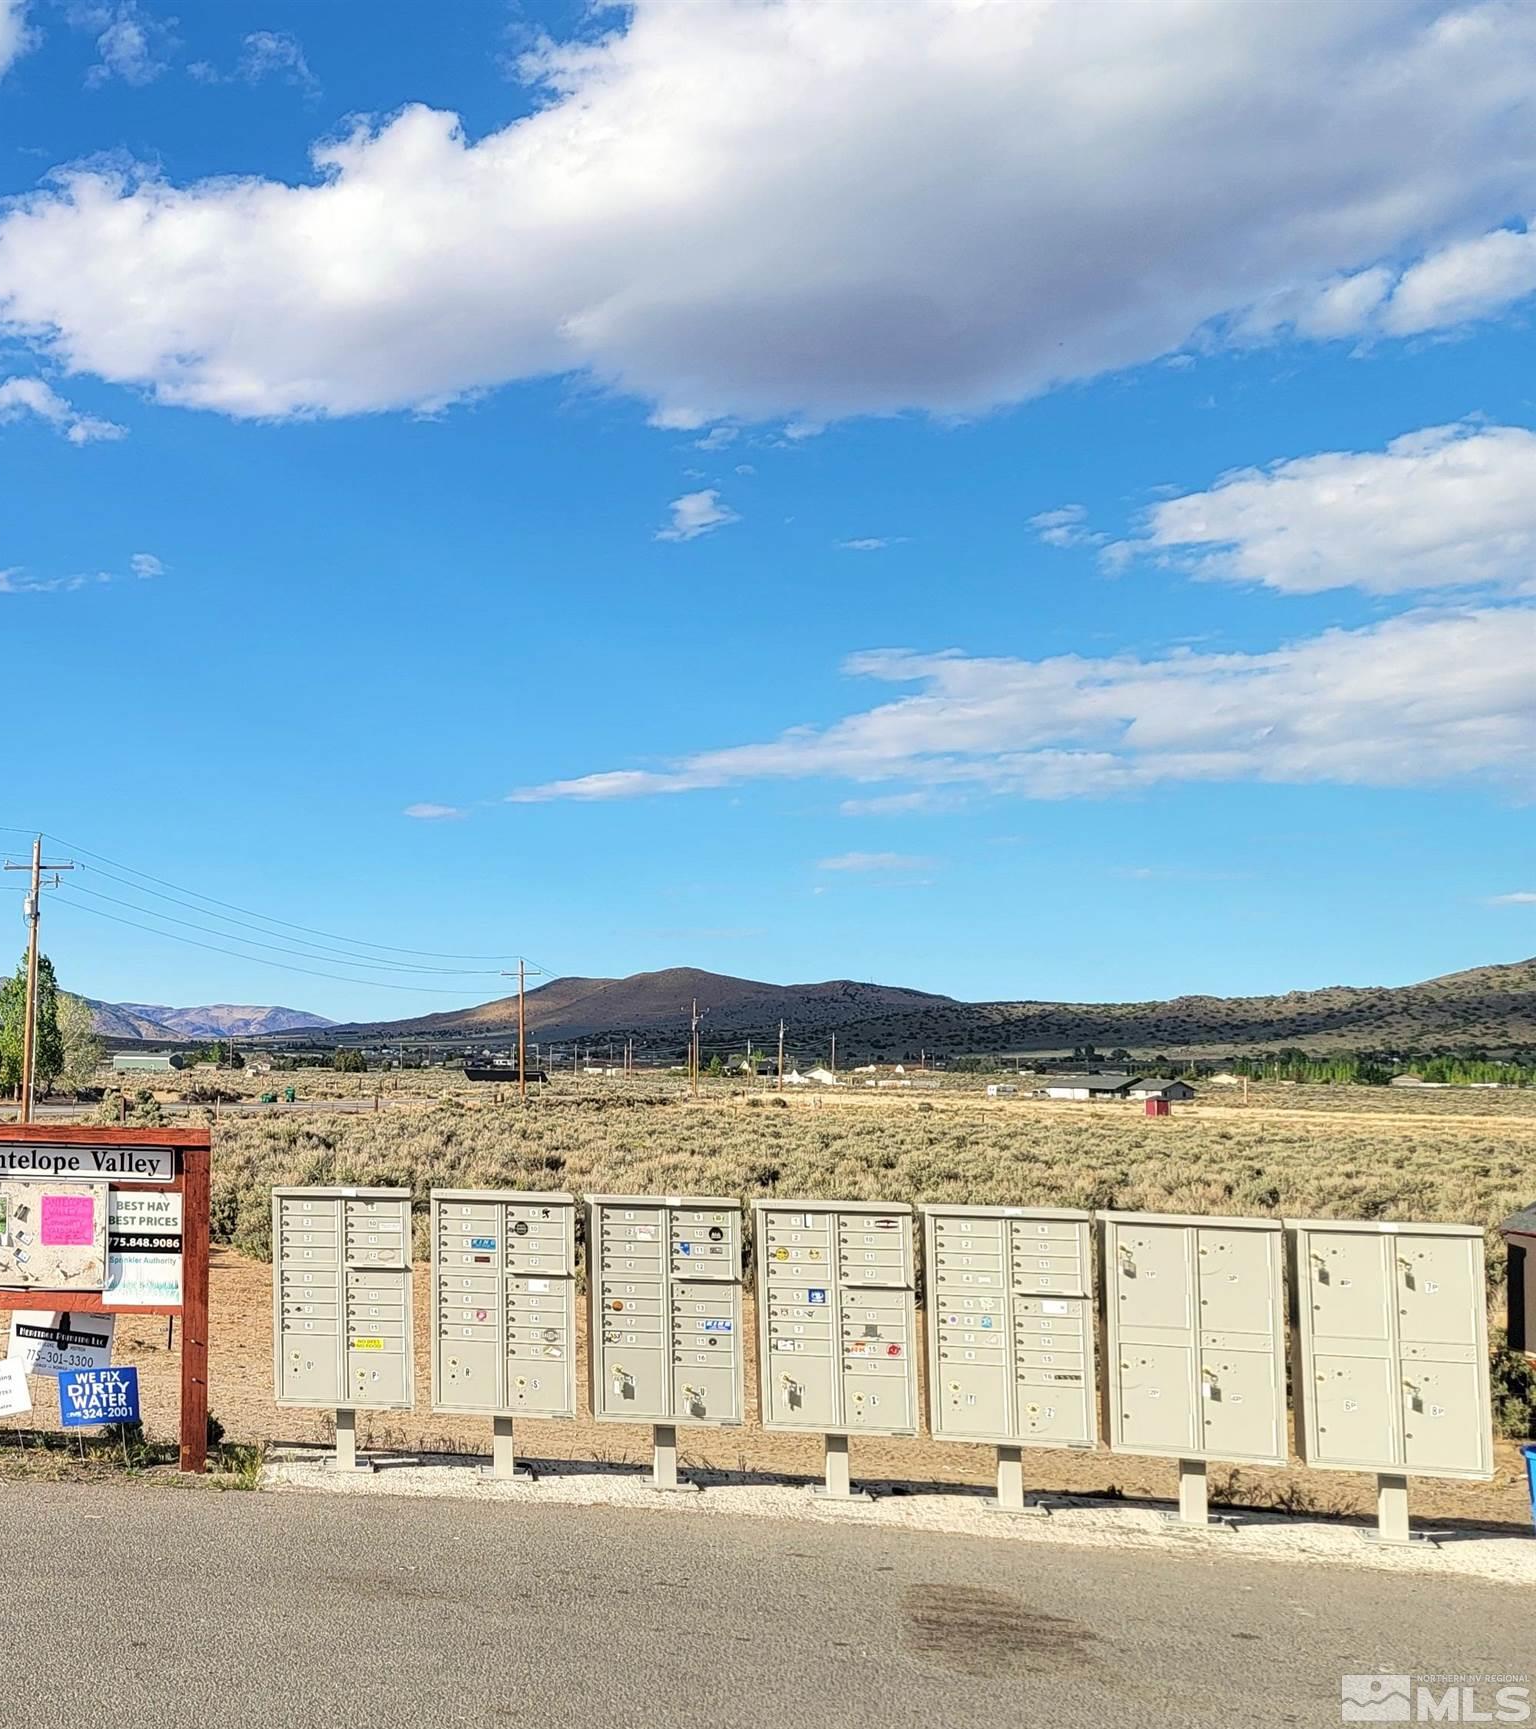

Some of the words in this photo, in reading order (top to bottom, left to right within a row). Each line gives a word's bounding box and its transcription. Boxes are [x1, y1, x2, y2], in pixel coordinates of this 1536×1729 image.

[91, 1151, 161, 1176] Valley
[117, 1201, 144, 1211] BEST
[147, 1202, 170, 1211] HAY
[109, 1216, 136, 1225] BEST
[139, 1217, 178, 1226] PRICES
[110, 1256, 141, 1264] Sprinkler
[144, 1257, 177, 1265] Authority
[26, 1349, 94, 1368] 775-301-3300
[75, 1372, 96, 1384] WE
[100, 1371, 120, 1382] FIX
[67, 1381, 130, 1397] DIRTY
[72, 1393, 127, 1409] WATER
[83, 1407, 133, 1419] 324-2001
